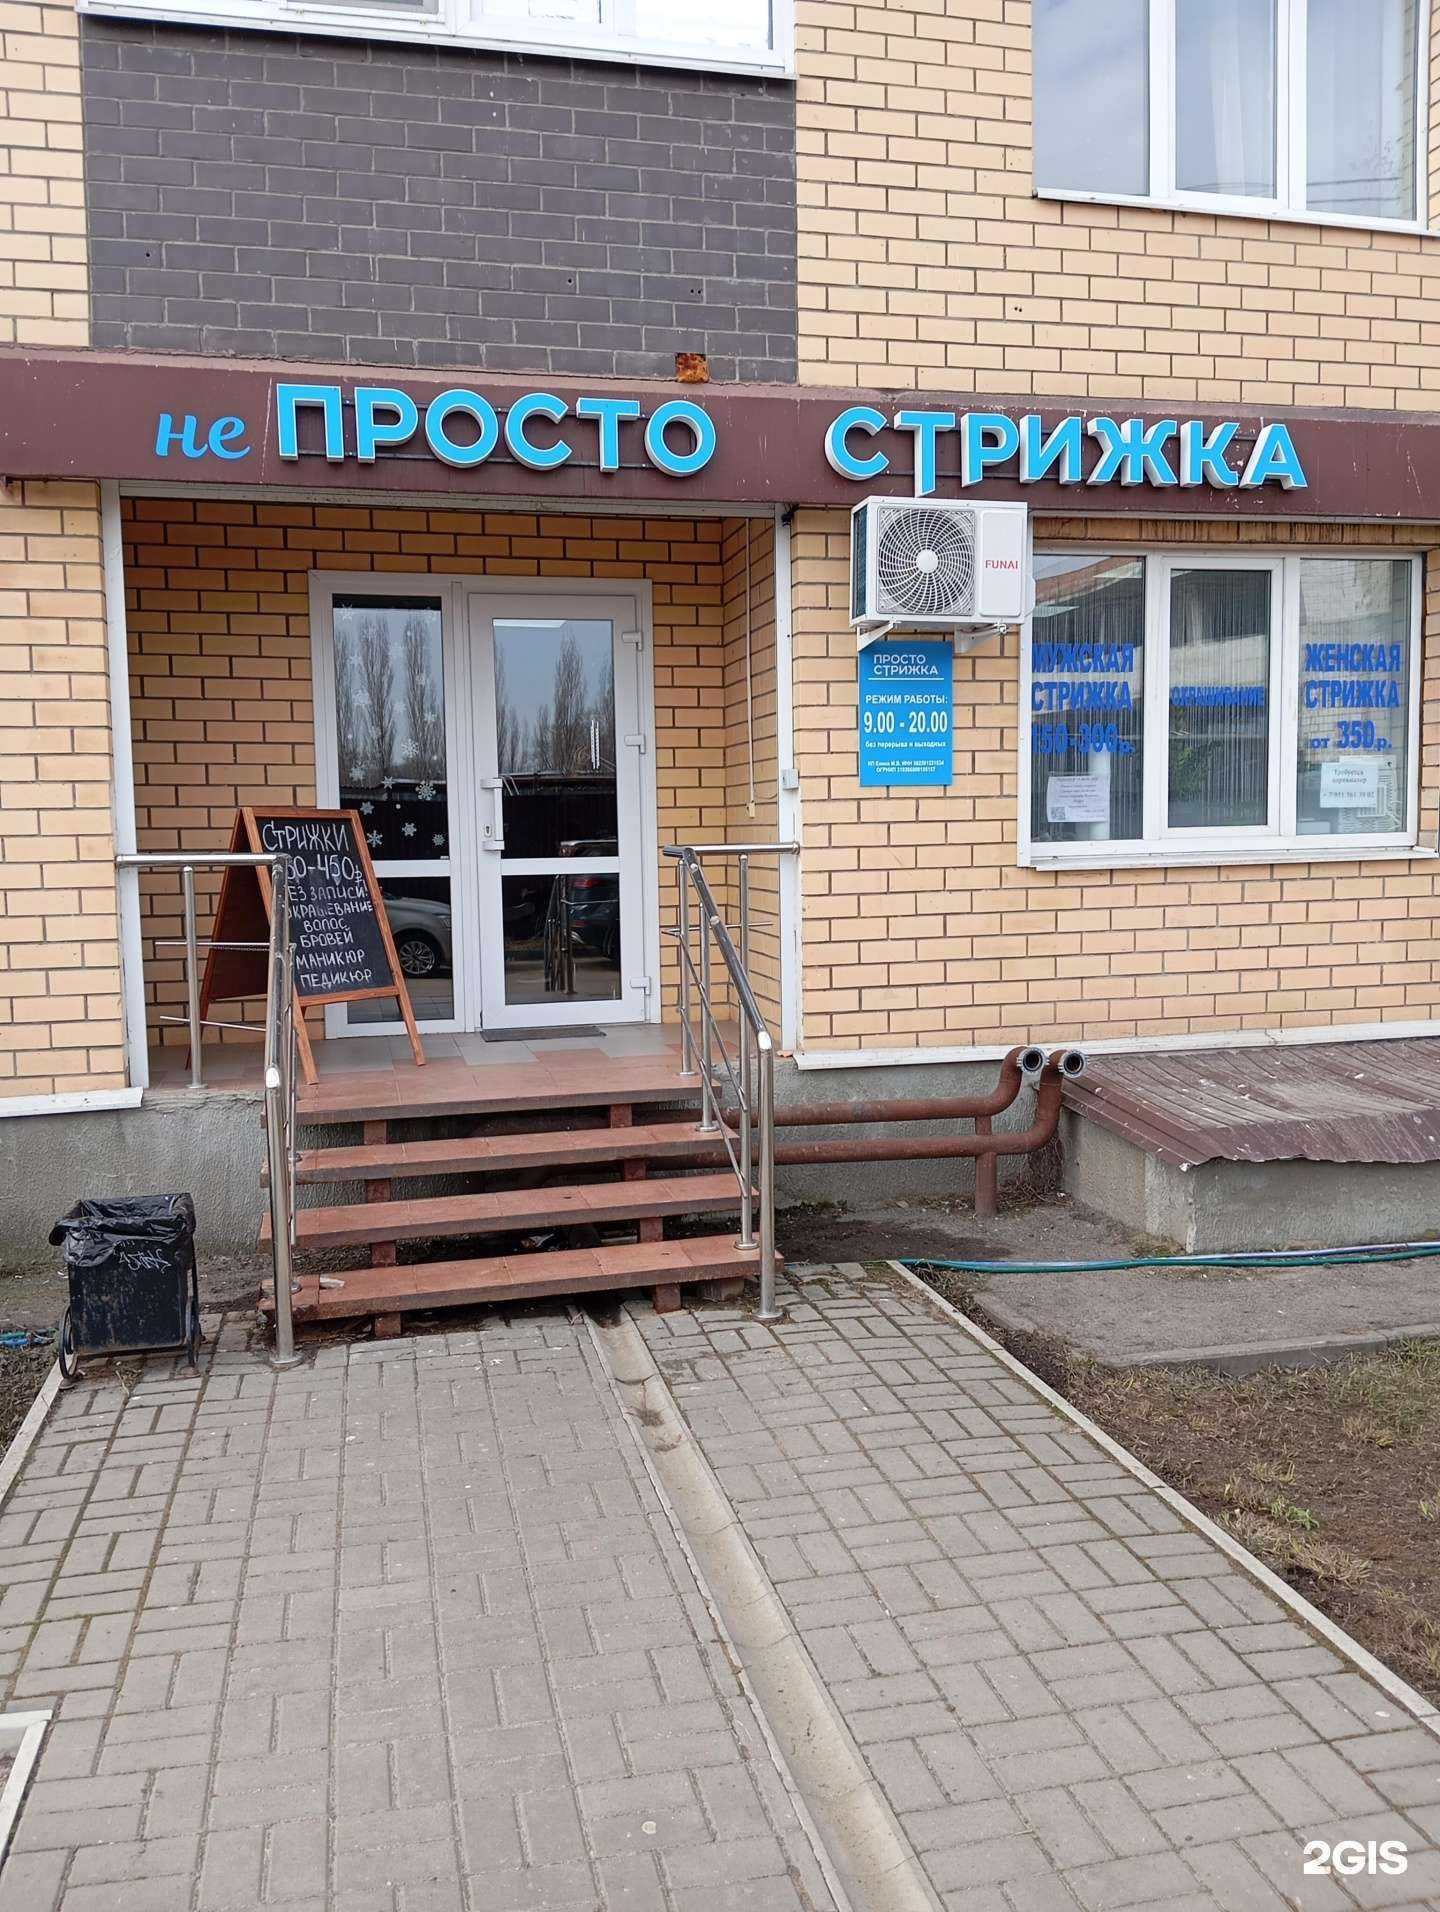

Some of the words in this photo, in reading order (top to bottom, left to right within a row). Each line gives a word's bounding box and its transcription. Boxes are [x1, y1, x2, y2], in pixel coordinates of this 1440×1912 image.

[155, 412, 250, 459] не
[276, 383, 717, 478] ПРОСТО
[824, 406, 1308, 498] СТРИЖКА
[985, 560, 1019, 571] FUNAI
[873, 654, 926, 664] ПРОСТО
[1032, 643, 1134, 673] МУЖСКАЯ
[1305, 642, 1400, 672] ЖЕНСКАЯ
[873, 665, 939, 677] СТРИЖКА
[865, 695, 902, 705] РЕЖИМ
[904, 695, 948, 705] РАБОТЫ:
[1032, 681, 1133, 711] СТРИЖКА
[1305, 680, 1400, 708] СТРИЖКА
[864, 711, 895, 733] 9.00
[908, 711, 948, 733] 20.00
[865, 740, 876, 748] без
[877, 741, 908, 749] перерыва
[1311, 736, 1329, 749] от
[262, 821, 349, 851] СТРИЖКИ
[287, 886, 307, 901] ЕЗ
[296, 949, 365, 970] МАНИКЮР
[300, 968, 372, 990] ПЕДИКЮР
